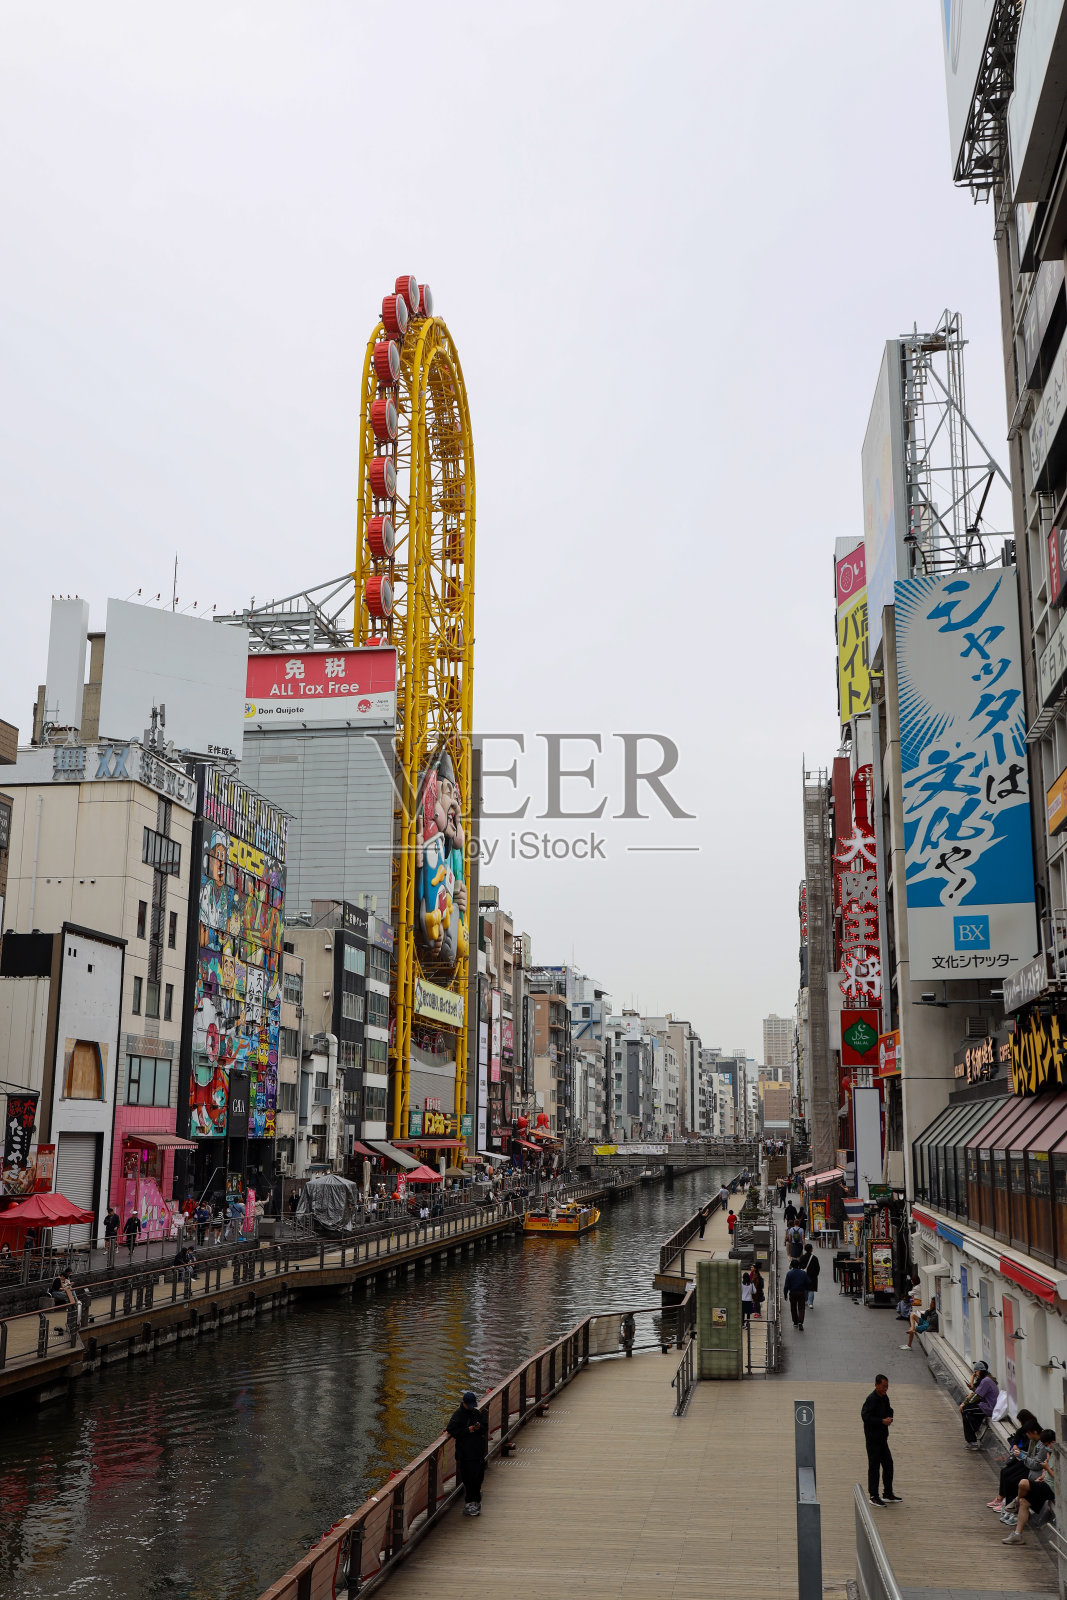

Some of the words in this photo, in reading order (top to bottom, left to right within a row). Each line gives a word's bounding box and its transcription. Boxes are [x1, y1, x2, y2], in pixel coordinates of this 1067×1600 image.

[285, 657, 346, 679] 免税
[843, 607, 861, 715] バイト
[269, 683, 294, 696] ALL
[298, 682, 324, 695] Tax
[328, 681, 359, 694] Free
[258, 707, 274, 715] Don
[275, 706, 305, 716] Quijote
[229, 835, 265, 881] 2025
[832, 826, 881, 999] 大阪王将
[958, 924, 985, 942] BX
[851, 1031, 870, 1041] حلال
[7, 1117, 24, 1180] たこやき
